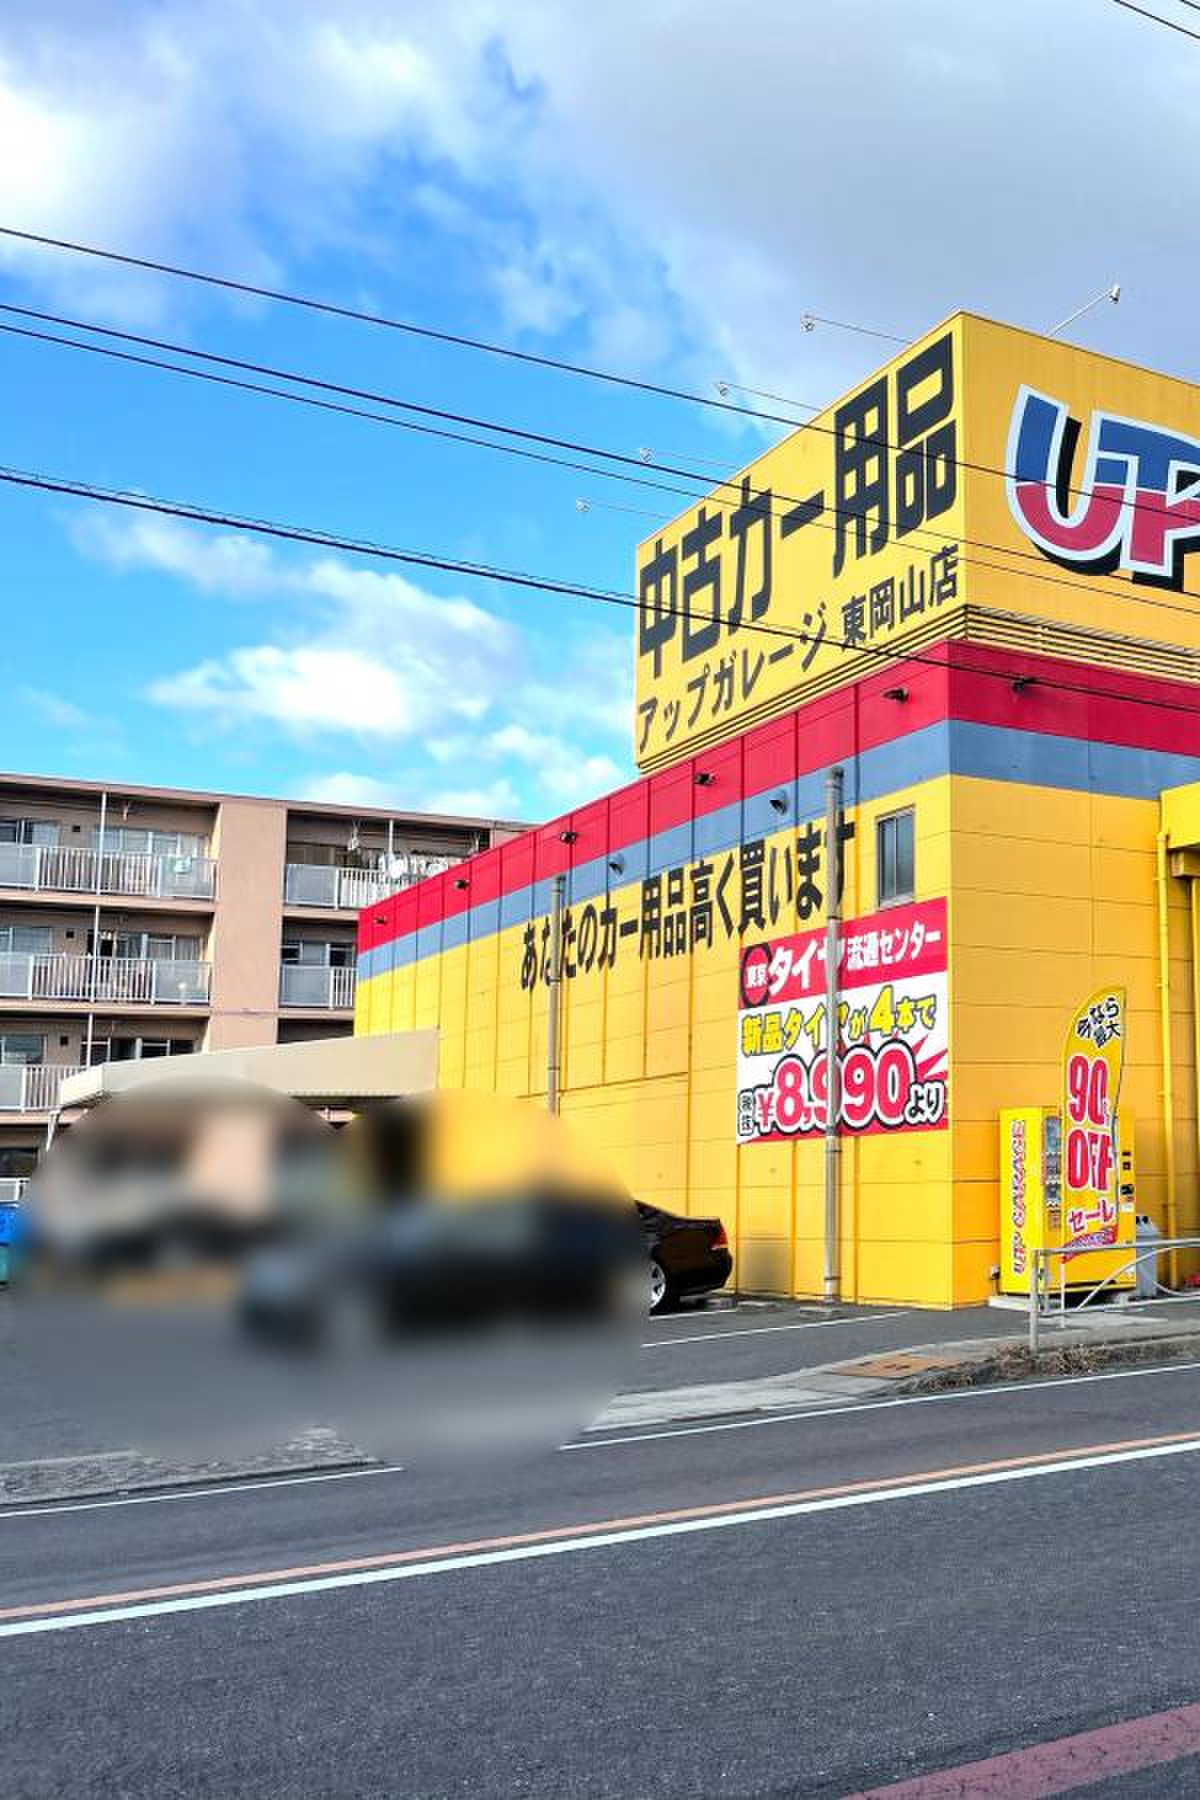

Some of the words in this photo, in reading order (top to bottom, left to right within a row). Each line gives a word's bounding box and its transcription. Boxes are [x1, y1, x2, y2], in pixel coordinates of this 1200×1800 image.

[640, 331, 957, 680] 中古カー用品
[639, 600, 827, 754] アップガレージ
[841, 544, 959, 651] 東岡山店
